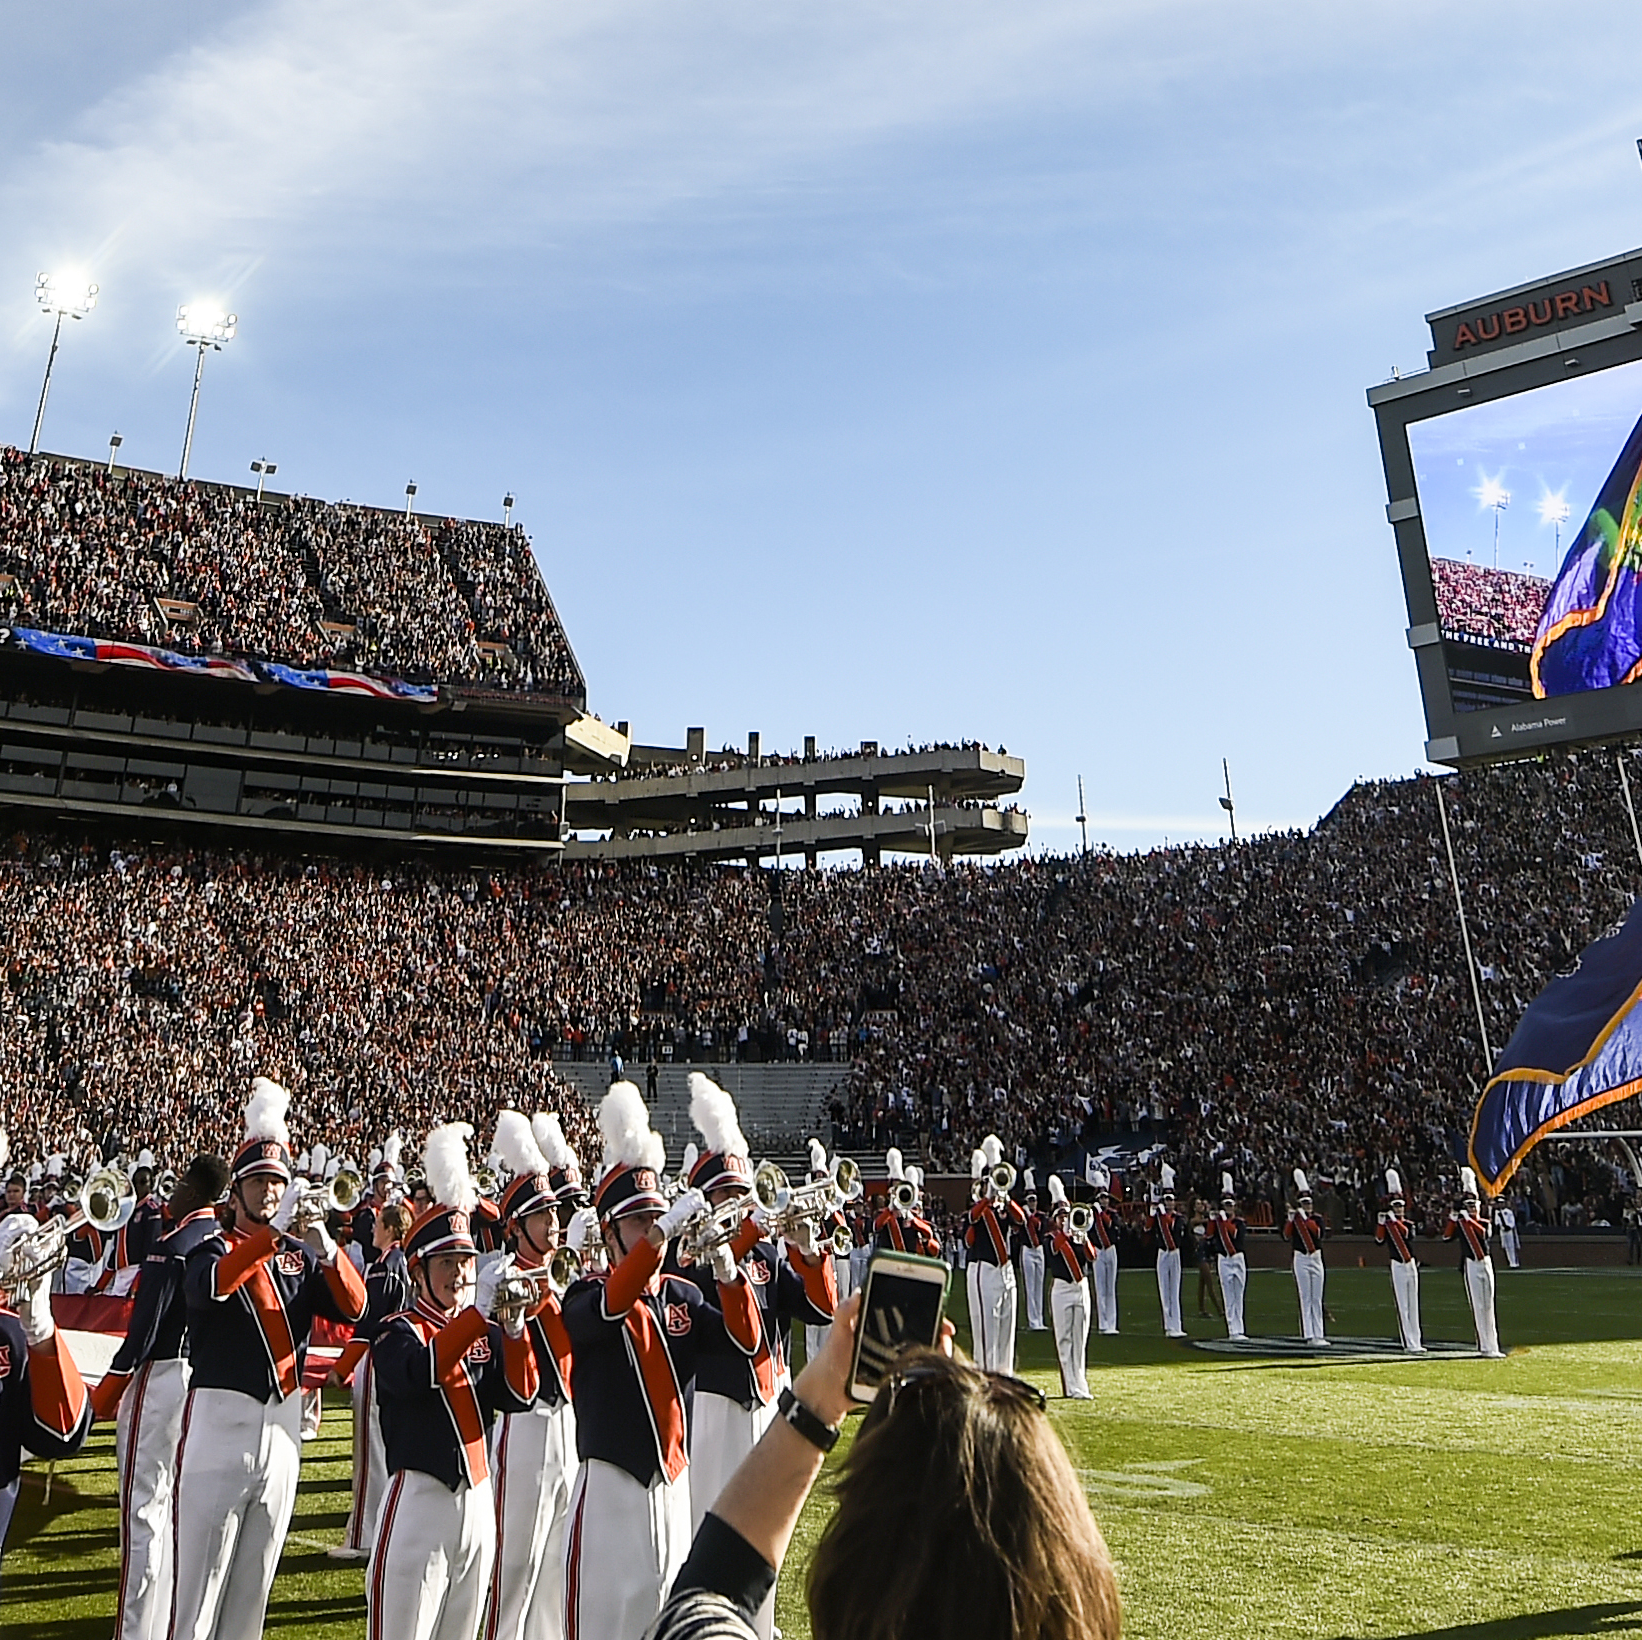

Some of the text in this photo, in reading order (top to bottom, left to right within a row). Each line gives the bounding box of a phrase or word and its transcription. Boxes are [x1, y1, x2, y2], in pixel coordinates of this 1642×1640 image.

[1454, 280, 1612, 348] AUBURN
[1463, 634, 1490, 647] FREE
[1493, 639, 1515, 651] AND
[1518, 644, 1534, 653] TH
[1511, 716, 1567, 733] Alabama Power
